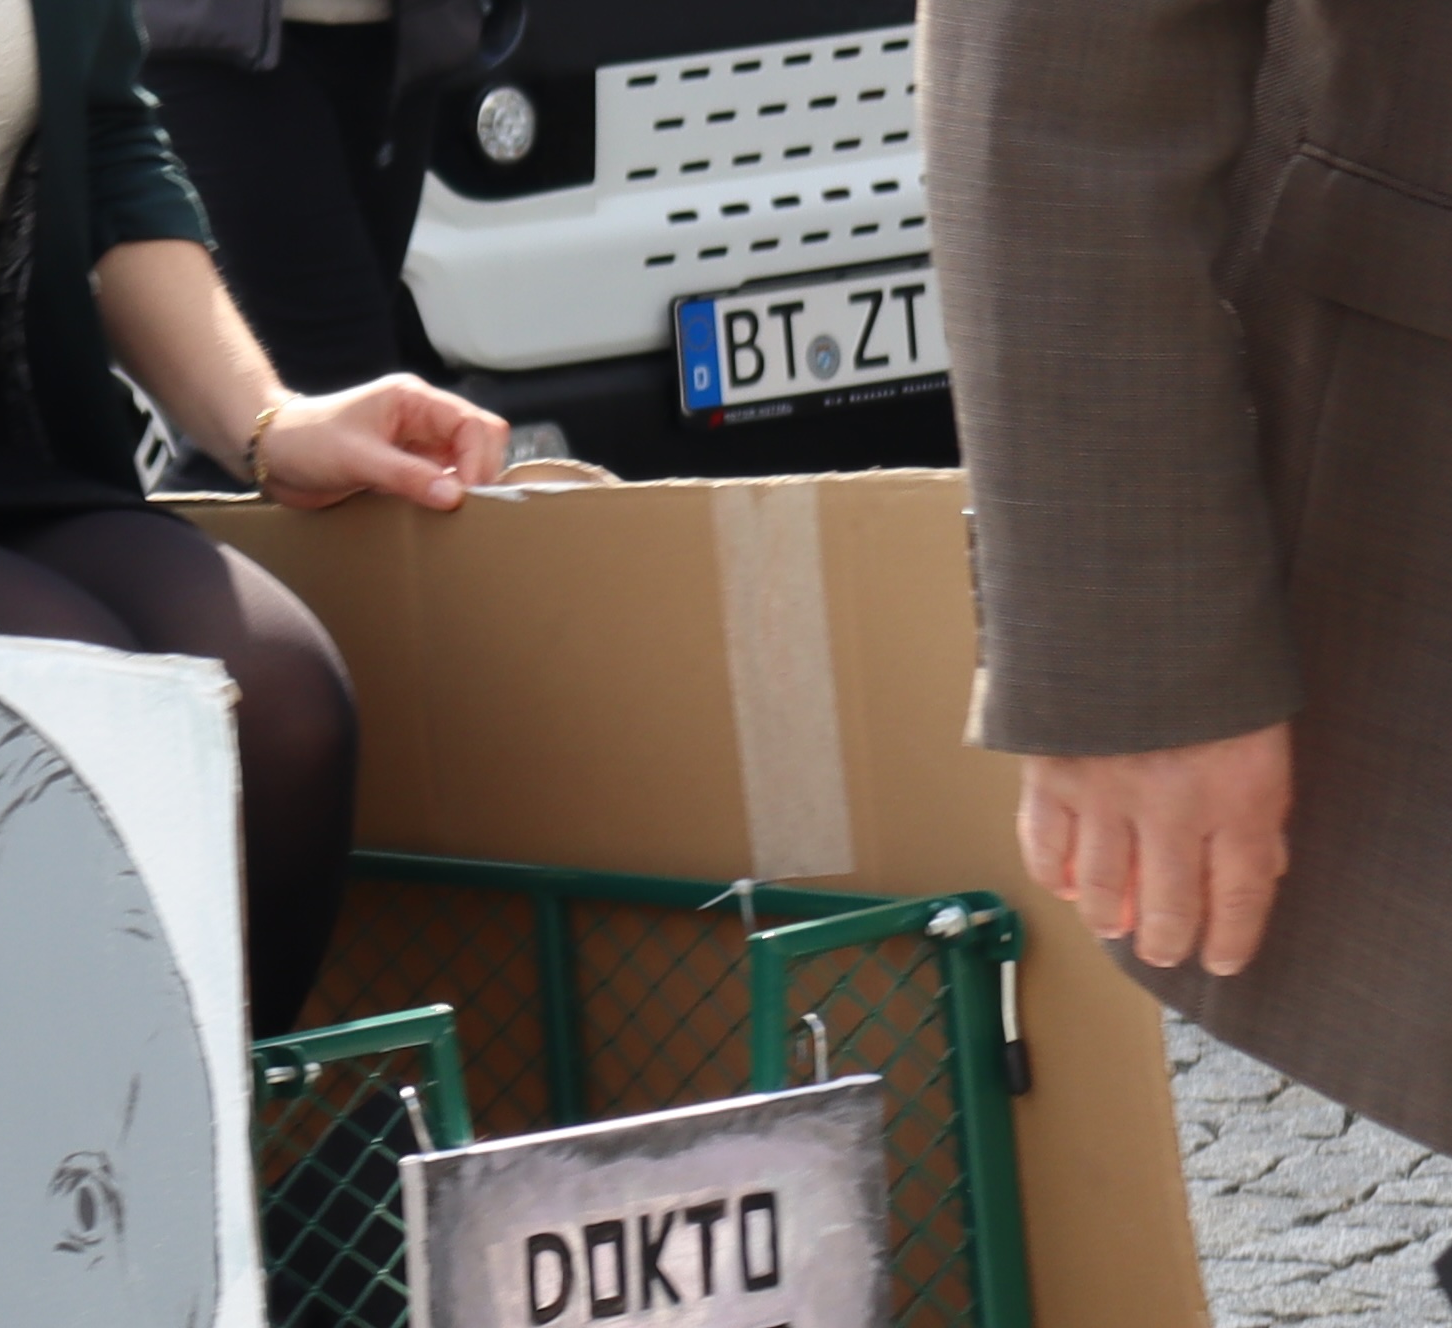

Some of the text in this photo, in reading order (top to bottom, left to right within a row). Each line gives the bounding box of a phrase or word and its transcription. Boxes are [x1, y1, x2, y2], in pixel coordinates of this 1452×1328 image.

[693, 366, 710, 391] D
[724, 283, 926, 387] BT ZT
[526, 1191, 780, 1326] DOKTO
